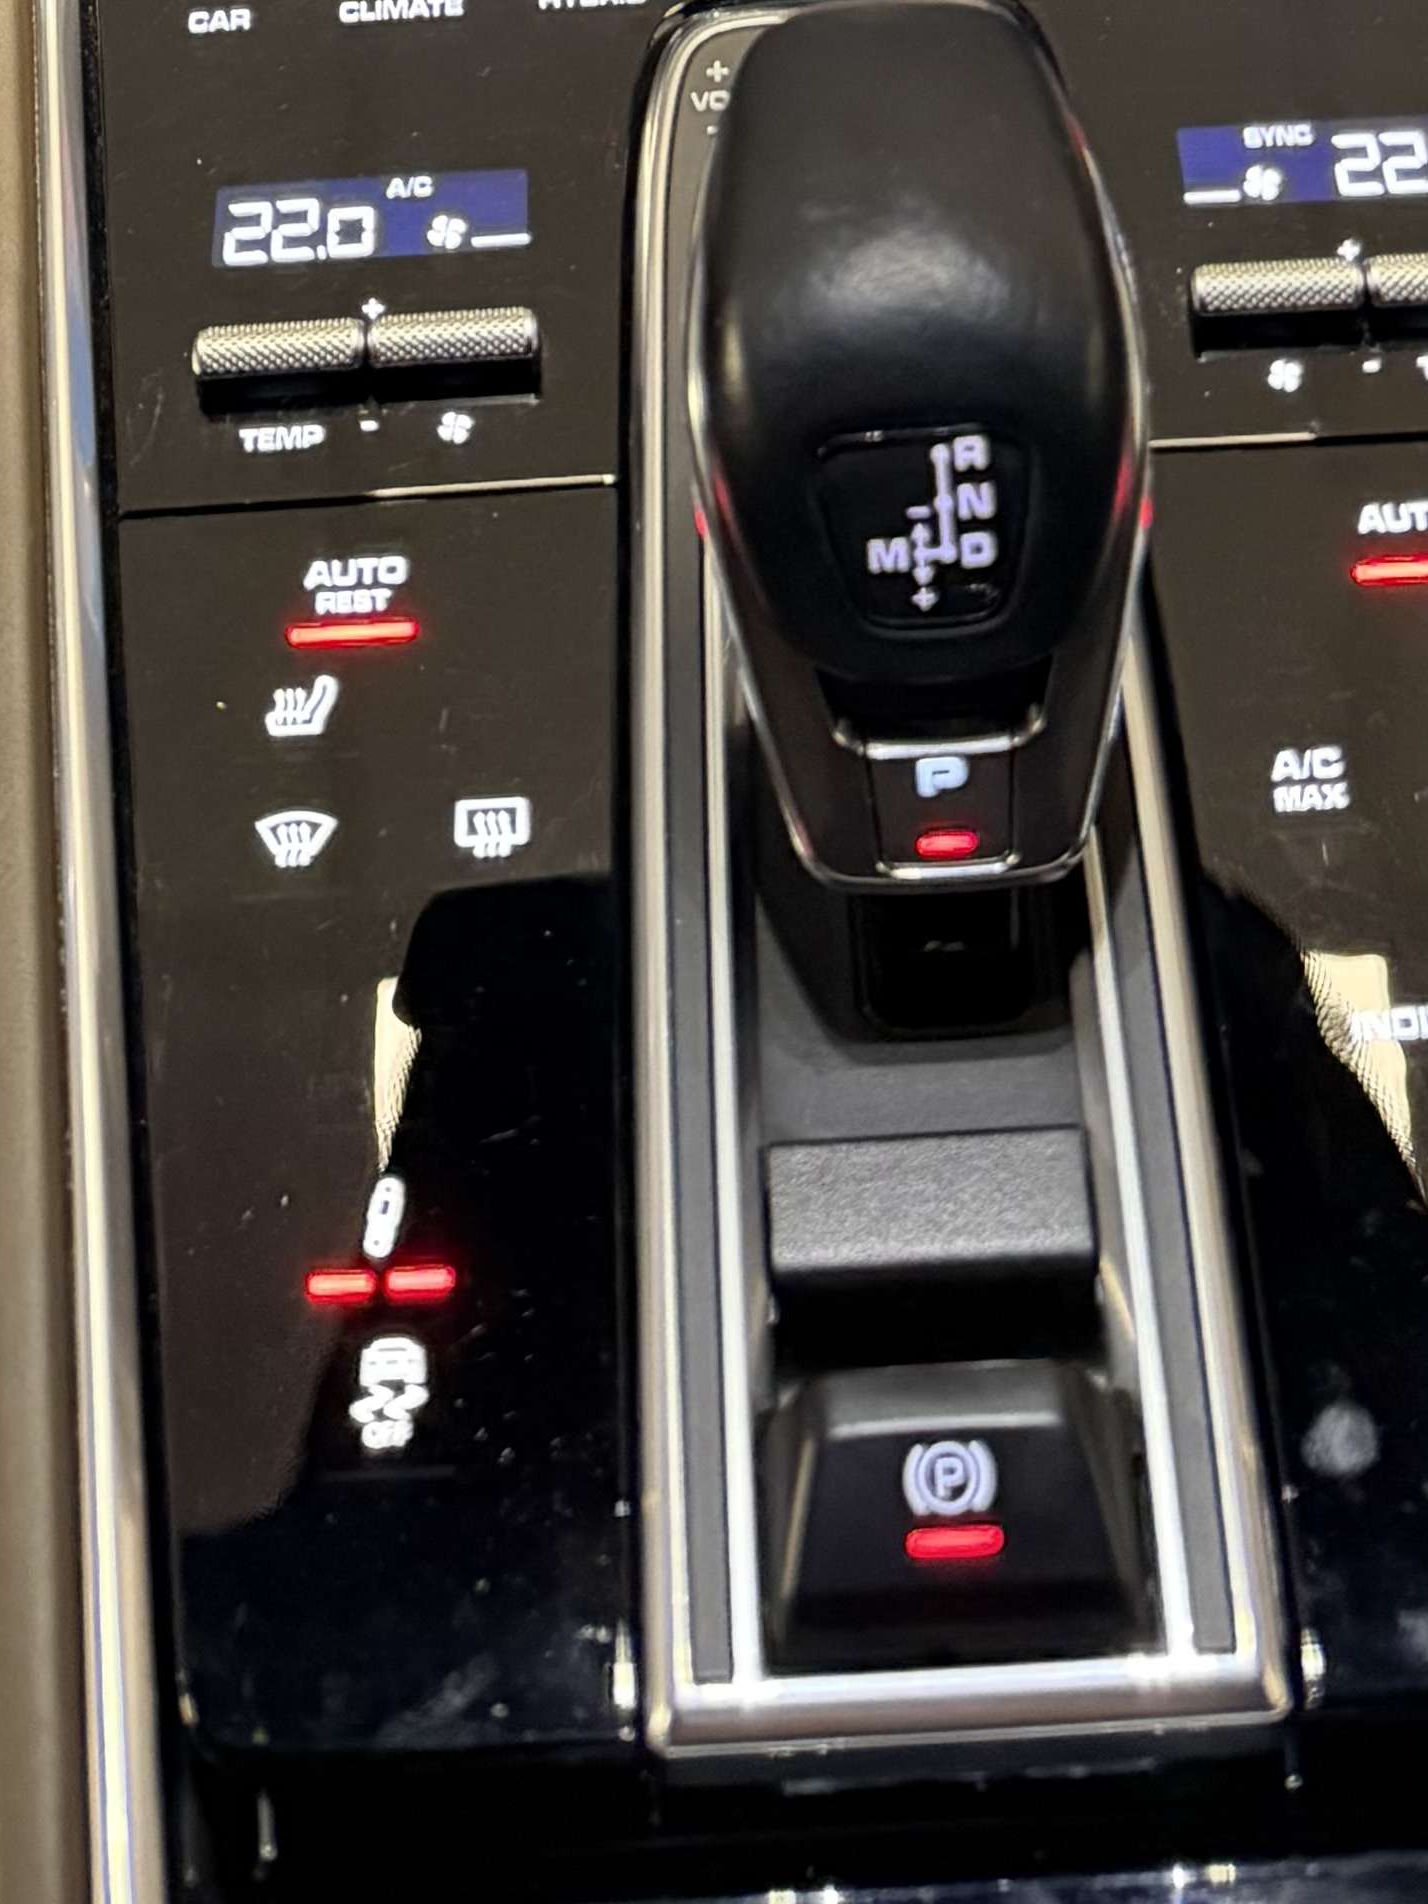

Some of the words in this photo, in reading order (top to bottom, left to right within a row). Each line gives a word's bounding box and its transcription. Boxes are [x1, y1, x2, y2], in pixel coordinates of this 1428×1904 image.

[188, 9, 251, 34] CAR
[1243, 124, 1314, 147] SYNC
[386, 176, 432, 198] A/C
[221, 198, 376, 266] 22.0
[239, 424, 325, 451] TEMP
[954, 435, 990, 471] R
[958, 484, 995, 519] N
[867, 538, 909, 574] M
[961, 533, 996, 568] D
[304, 556, 409, 589] AUTO
[316, 589, 392, 614] REST
[916, 757, 969, 797] P
[1272, 745, 1345, 782] A/C
[1274, 782, 1350, 812] MAX
